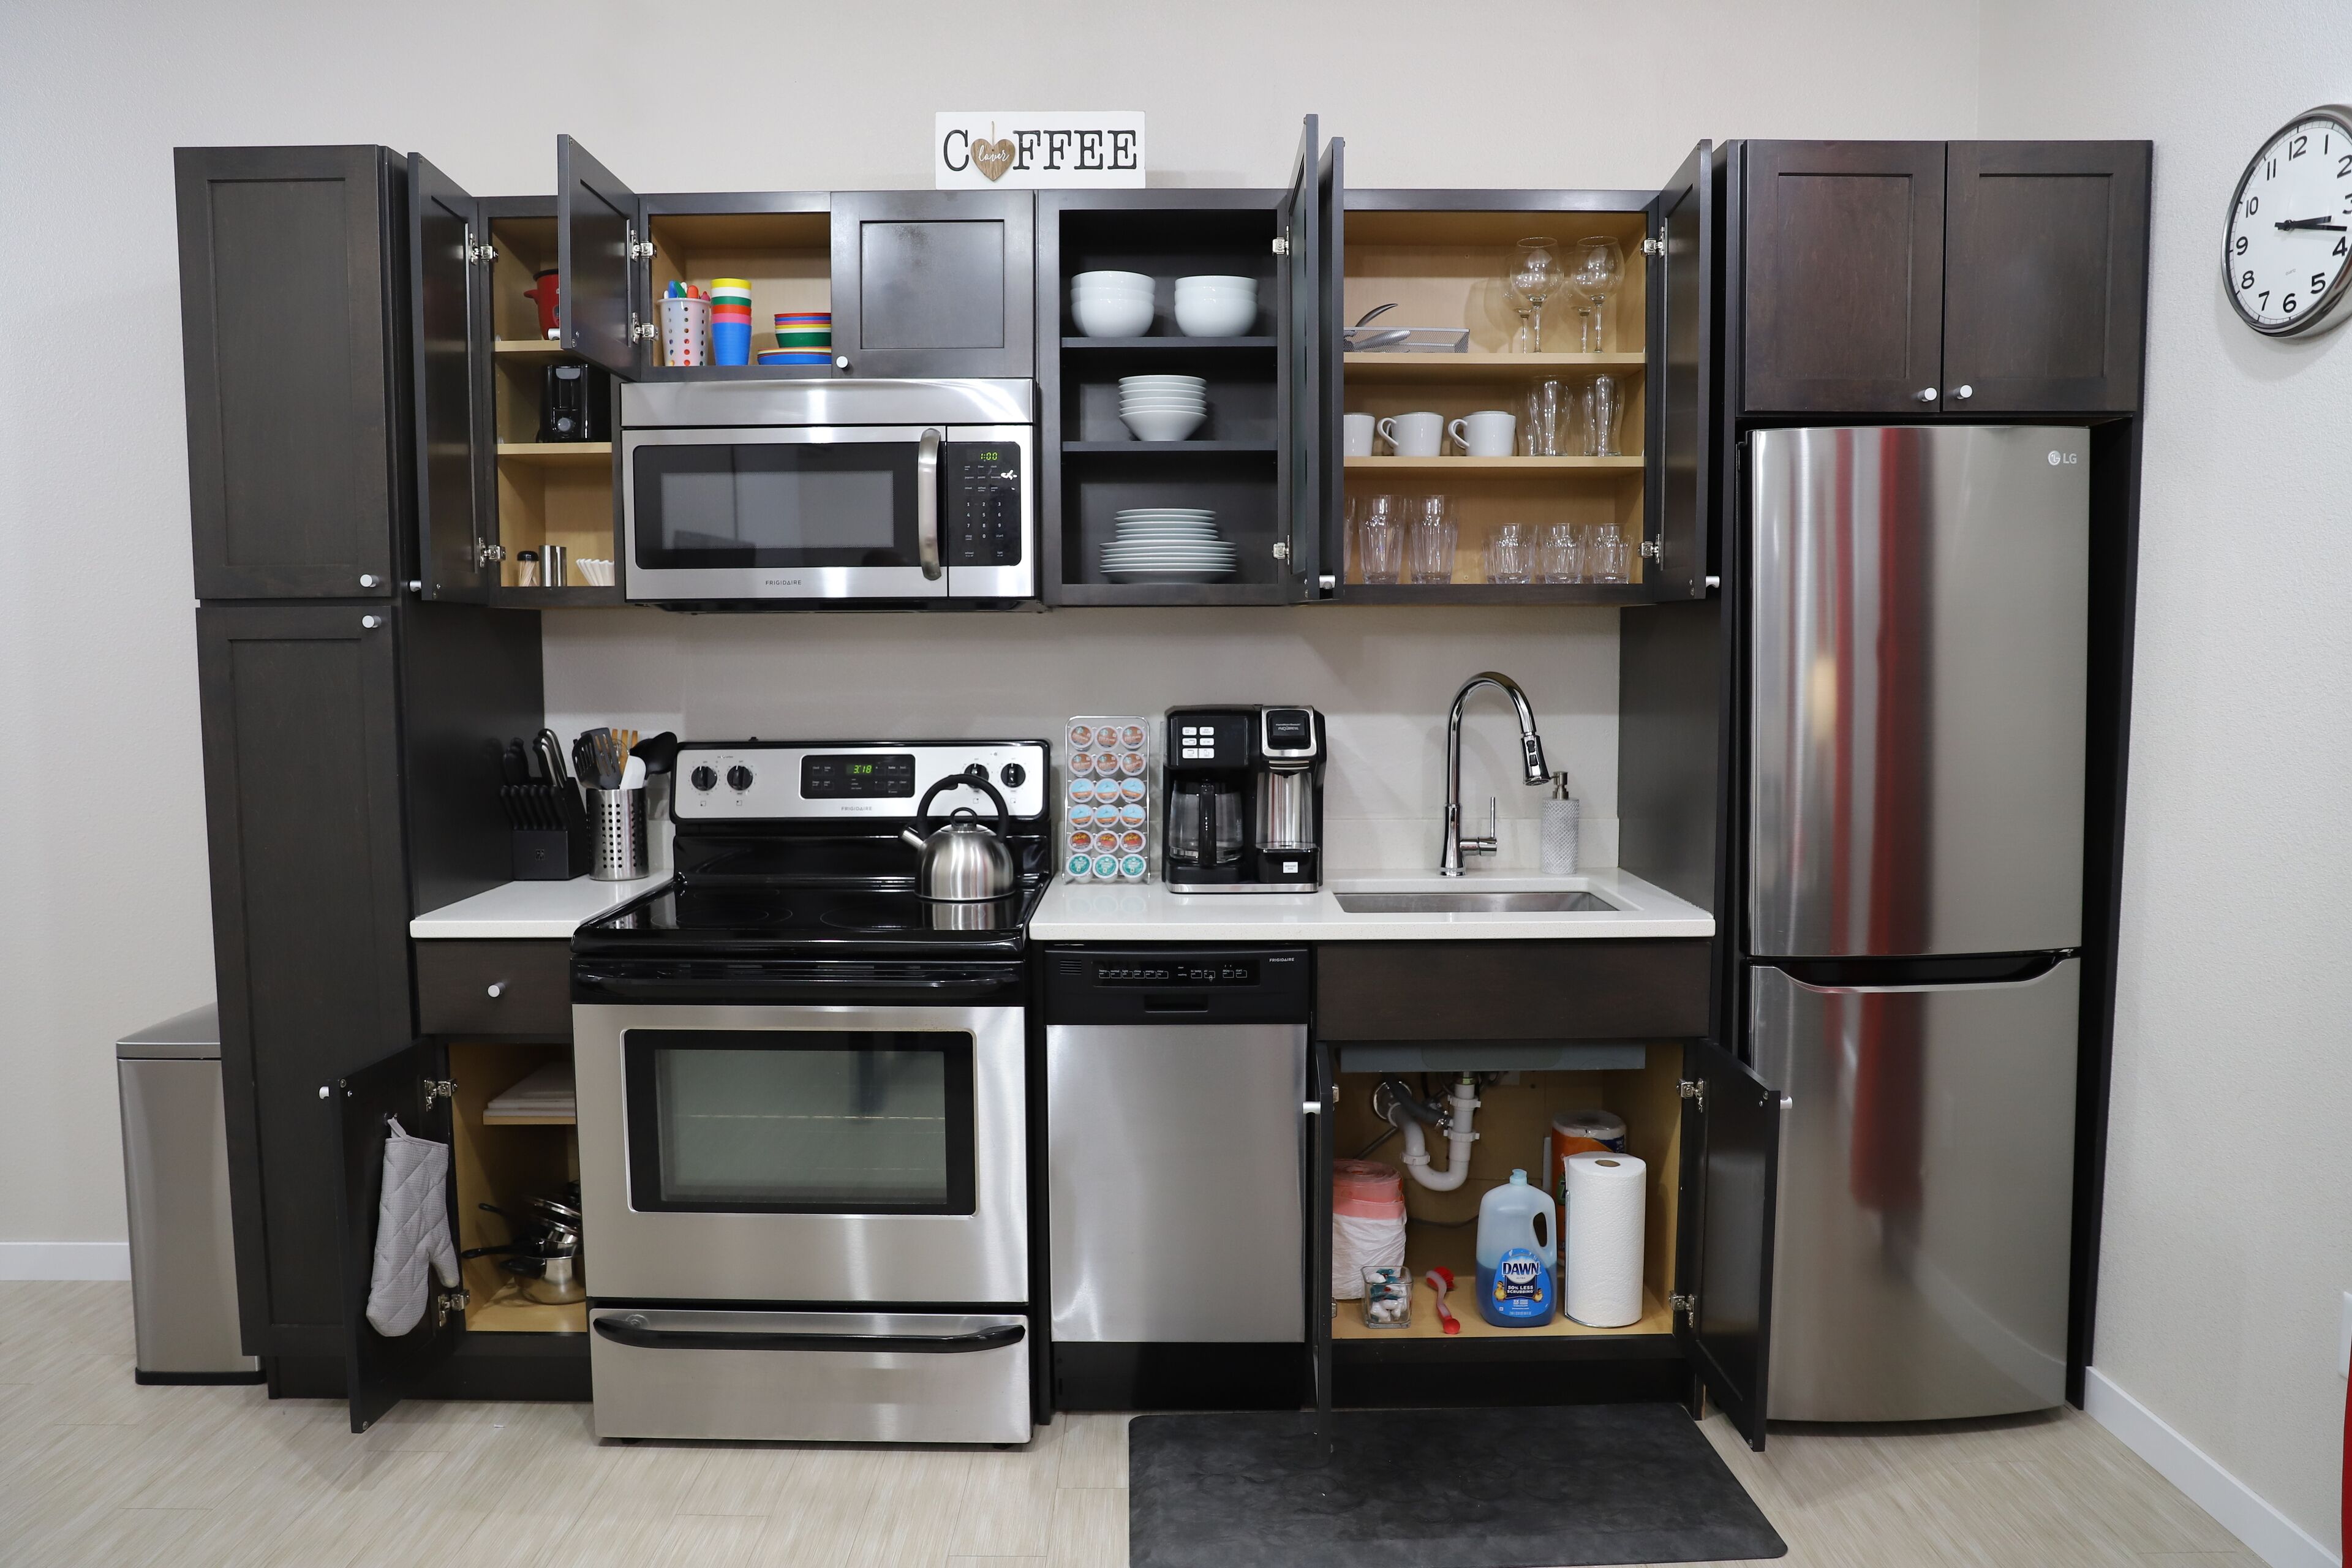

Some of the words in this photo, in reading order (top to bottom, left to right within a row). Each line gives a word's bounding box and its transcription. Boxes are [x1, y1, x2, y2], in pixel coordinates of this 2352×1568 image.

[943, 129, 1137, 172] CFFEE
[979, 145, 1010, 162] lover
[2288, 135, 2308, 161] 12
[2324, 134, 2329, 155] 1
[2266, 159, 2277, 181] 11
[2337, 154, 2352, 179] 2
[2245, 196, 2259, 218] 10
[2236, 236, 2248, 256] 9
[2332, 236, 2348, 257] 4
[2241, 270, 2255, 290] 8
[2310, 272, 2326, 295] 5
[2258, 290, 2270, 311] 7
[2283, 293, 2297, 313] 6
[2063, 453, 2078, 464] LG
[1502, 1262, 1539, 1275] DAWN
